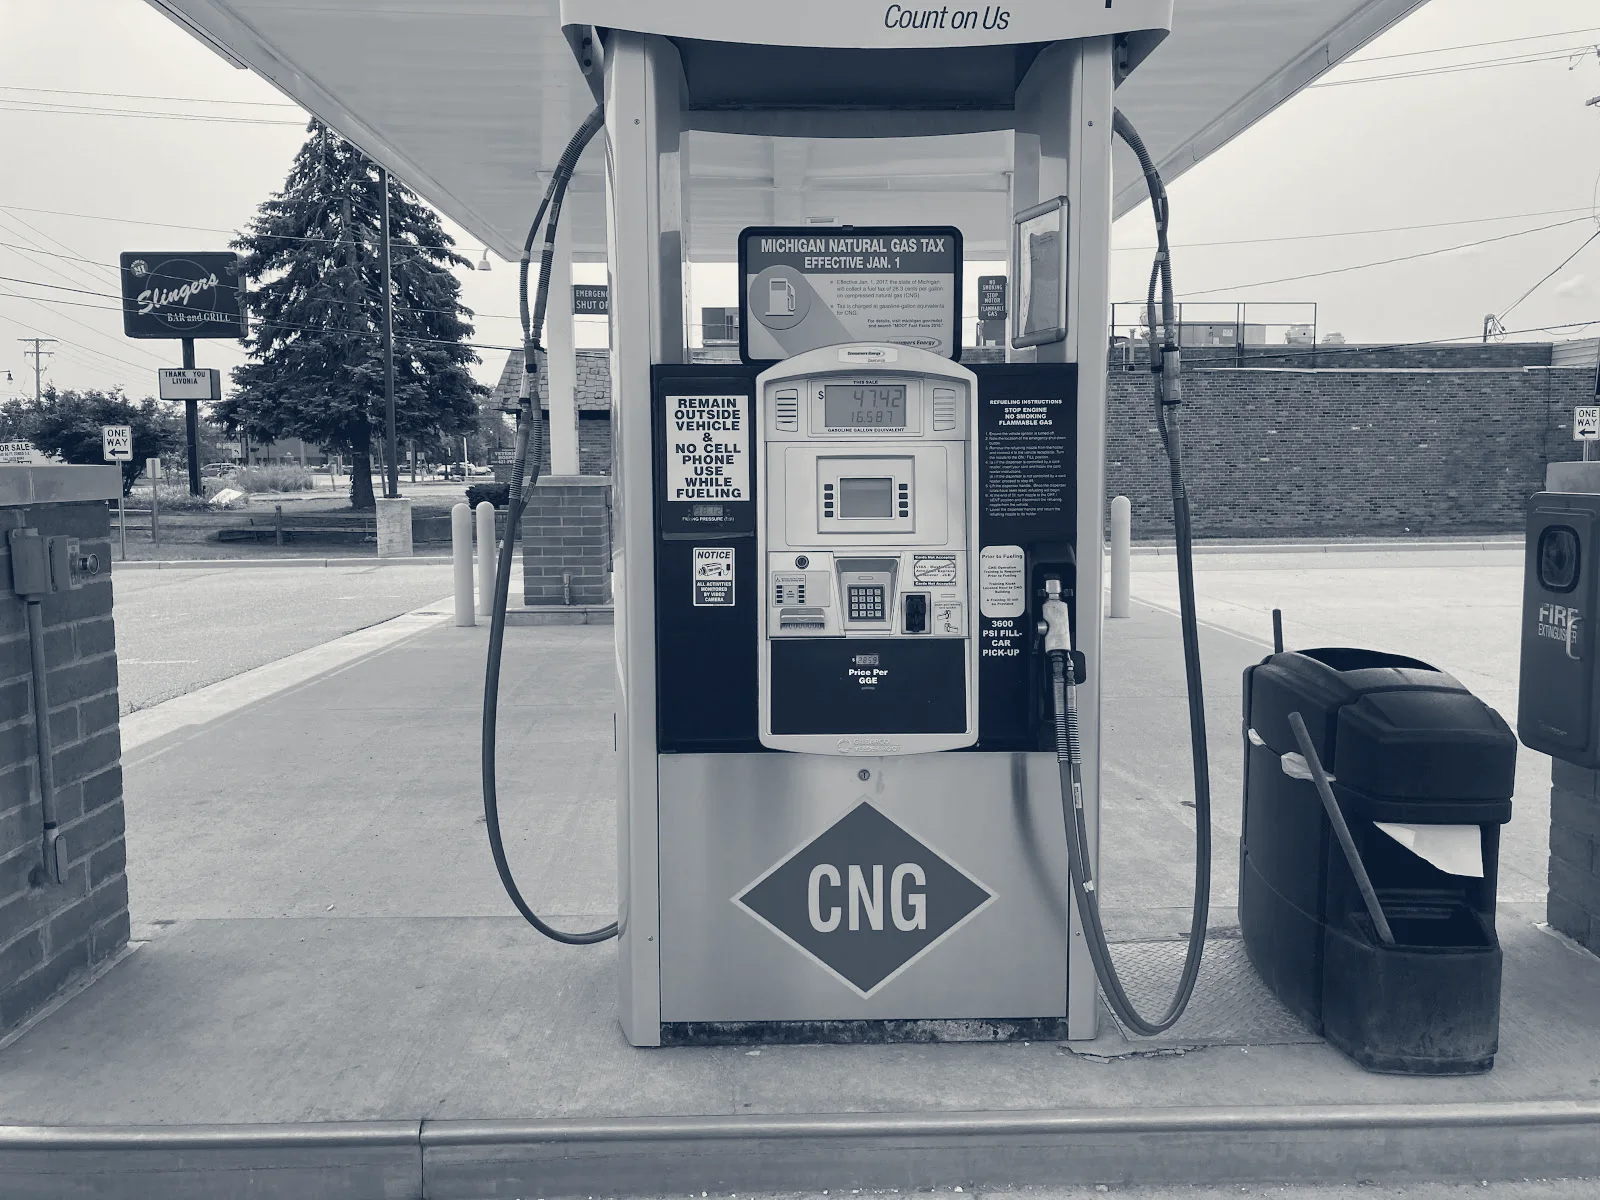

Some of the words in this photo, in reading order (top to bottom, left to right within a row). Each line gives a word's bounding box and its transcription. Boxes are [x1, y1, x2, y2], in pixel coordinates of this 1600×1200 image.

[885, 4, 948, 29] Count
[951, 10, 978, 29] on
[983, 6, 1010, 30] Us
[761, 238, 825, 252] MICHIGAN
[829, 238, 887, 252] NATURAL
[890, 238, 918, 252] GAS
[921, 238, 944, 252] TAX
[804, 256, 864, 268] EFFECTIVE
[866, 256, 891, 268] JAN.
[894, 256, 900, 268] 1
[137, 272, 220, 315] Slingers
[576, 300, 596, 309] SHUT
[167, 313, 185, 322] BAR
[186, 312, 202, 321] and
[204, 313, 230, 322] GRILL
[678, 399, 736, 408] REMAIN
[818, 391, 824, 400] $
[854, 390, 902, 408] 47.42
[674, 410, 740, 420] OUTSIDE
[852, 411, 893, 423] 16.587
[676, 421, 740, 431] VEHICLE
[703, 432, 713, 442] &
[676, 444, 696, 453] NO
[704, 444, 741, 453] CELL
[683, 455, 734, 464] PHONE
[694, 466, 723, 476] USE
[685, 478, 732, 487] WHILE
[677, 488, 741, 498] FUELING
[1539, 603, 1578, 629] FIRE
[1538, 623, 1577, 644] EXTINGUISER
[808, 862, 926, 933] CNG
